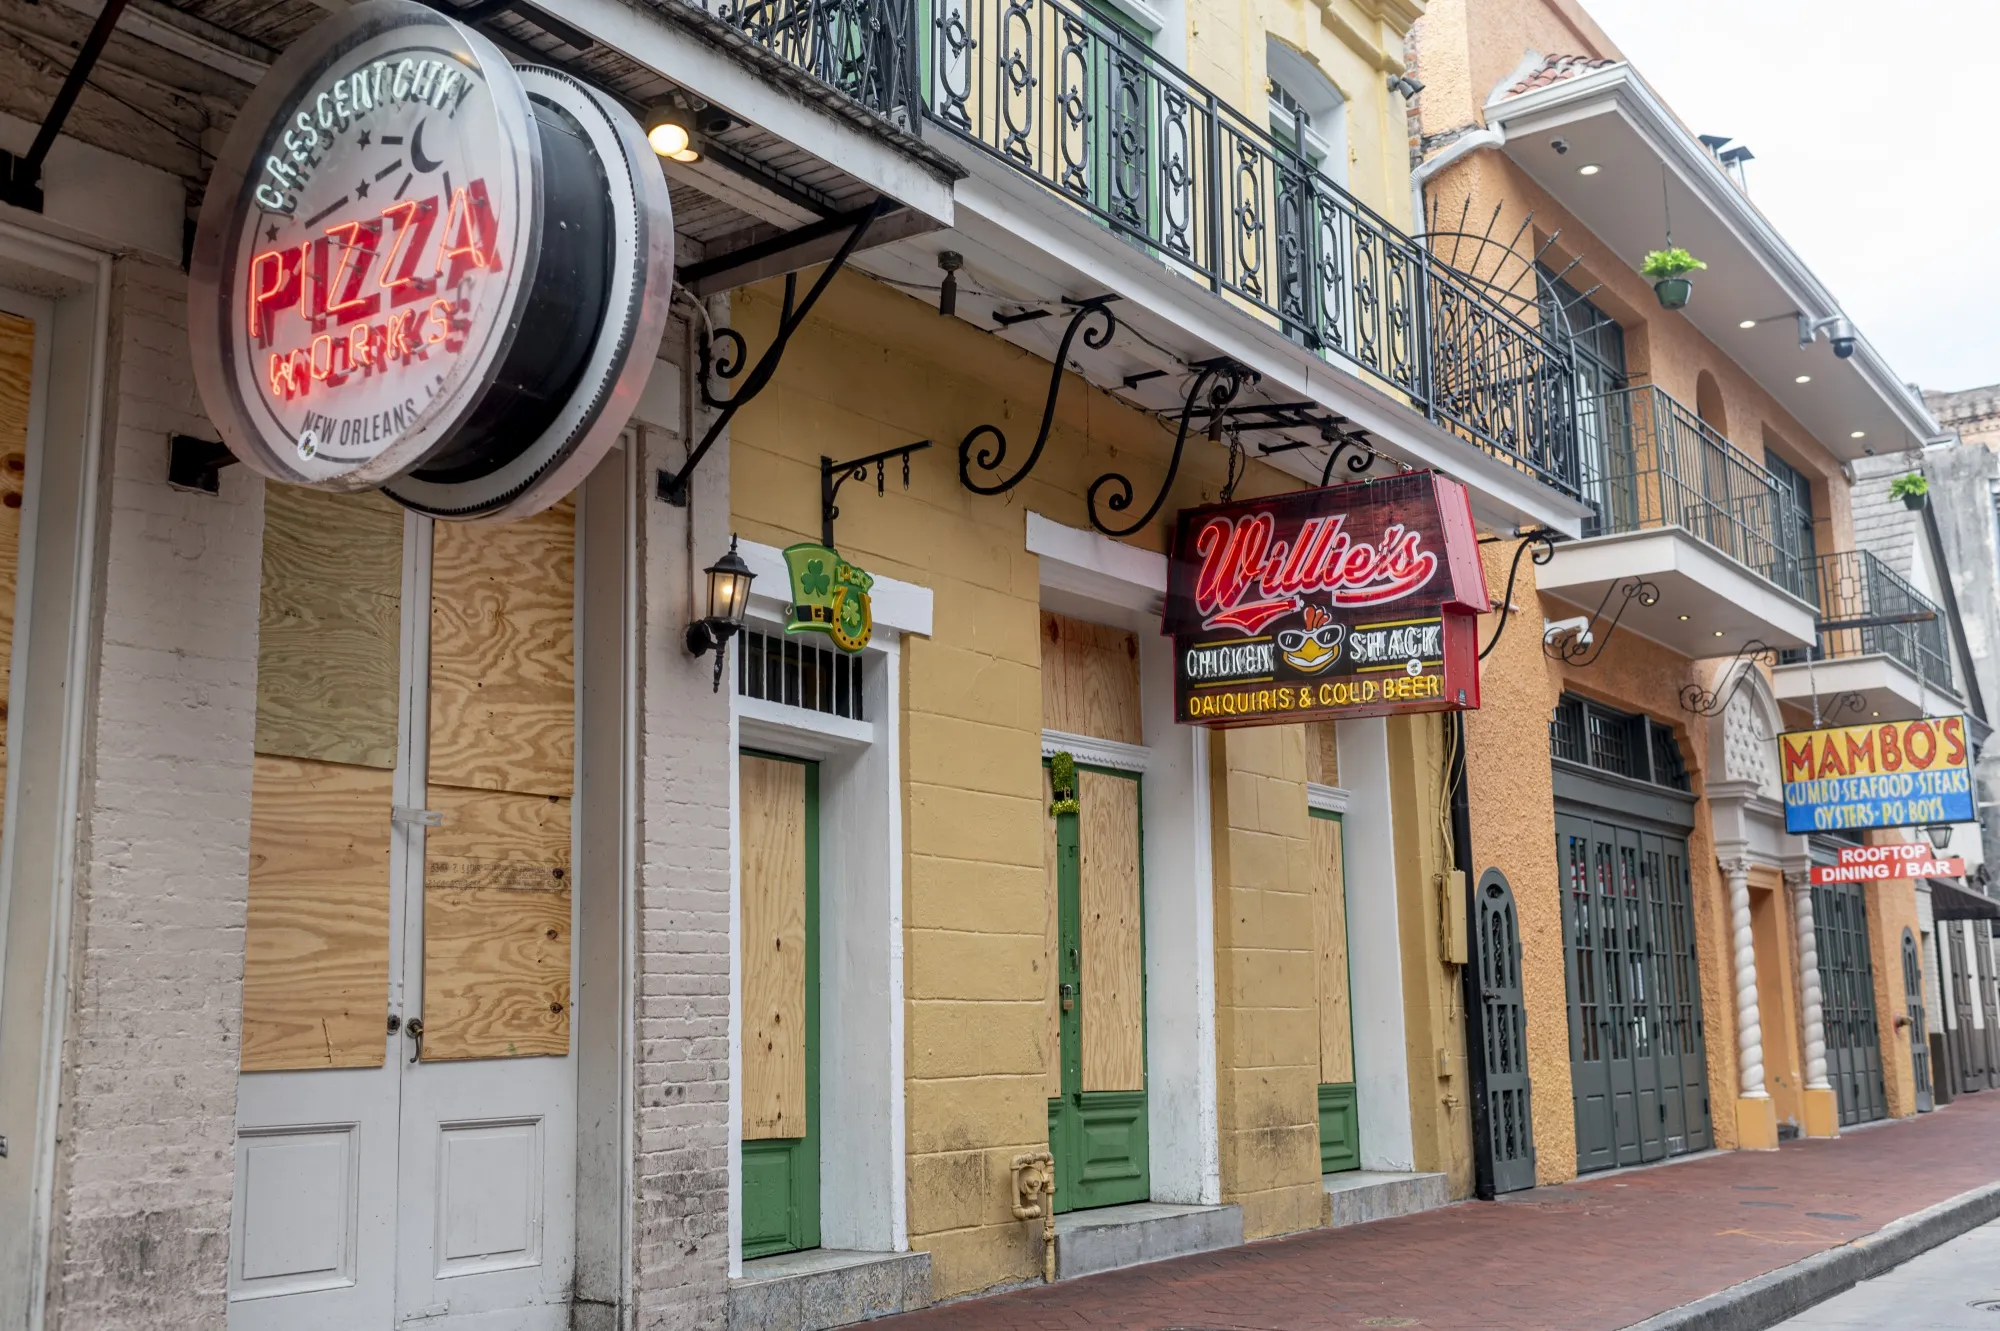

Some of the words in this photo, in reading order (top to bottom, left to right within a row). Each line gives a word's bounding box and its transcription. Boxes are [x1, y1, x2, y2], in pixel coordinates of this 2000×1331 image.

[256, 60, 392, 212] CRESCENT
[392, 57, 470, 118] CITY
[250, 178, 503, 349] PIZZA
[271, 299, 472, 400] WORKS
[301, 410, 337, 445] NEW
[340, 398, 421, 446] ORLEANS
[1195, 511, 1438, 618] Willie's
[1187, 643, 1275, 678] CHICKEN
[1349, 625, 1441, 662] SHACK
[1190, 688, 1295, 717] DAIQUIRIS
[1298, 688, 1315, 708] &
[1320, 680, 1379, 706] COLD
[1384, 675, 1443, 700] BEER
[1784, 718, 1965, 783] MAMBO'S
[1785, 779, 1840, 806] GUMBO
[1842, 774, 1913, 802] SEAFOOD
[1917, 768, 1971, 796] STEAKS
[1814, 803, 1875, 830] OYSTERS
[1821, 864, 1889, 882] DINING
[1906, 861, 1951, 877] BAR
[1841, 845, 1927, 863] ROOFTOP
